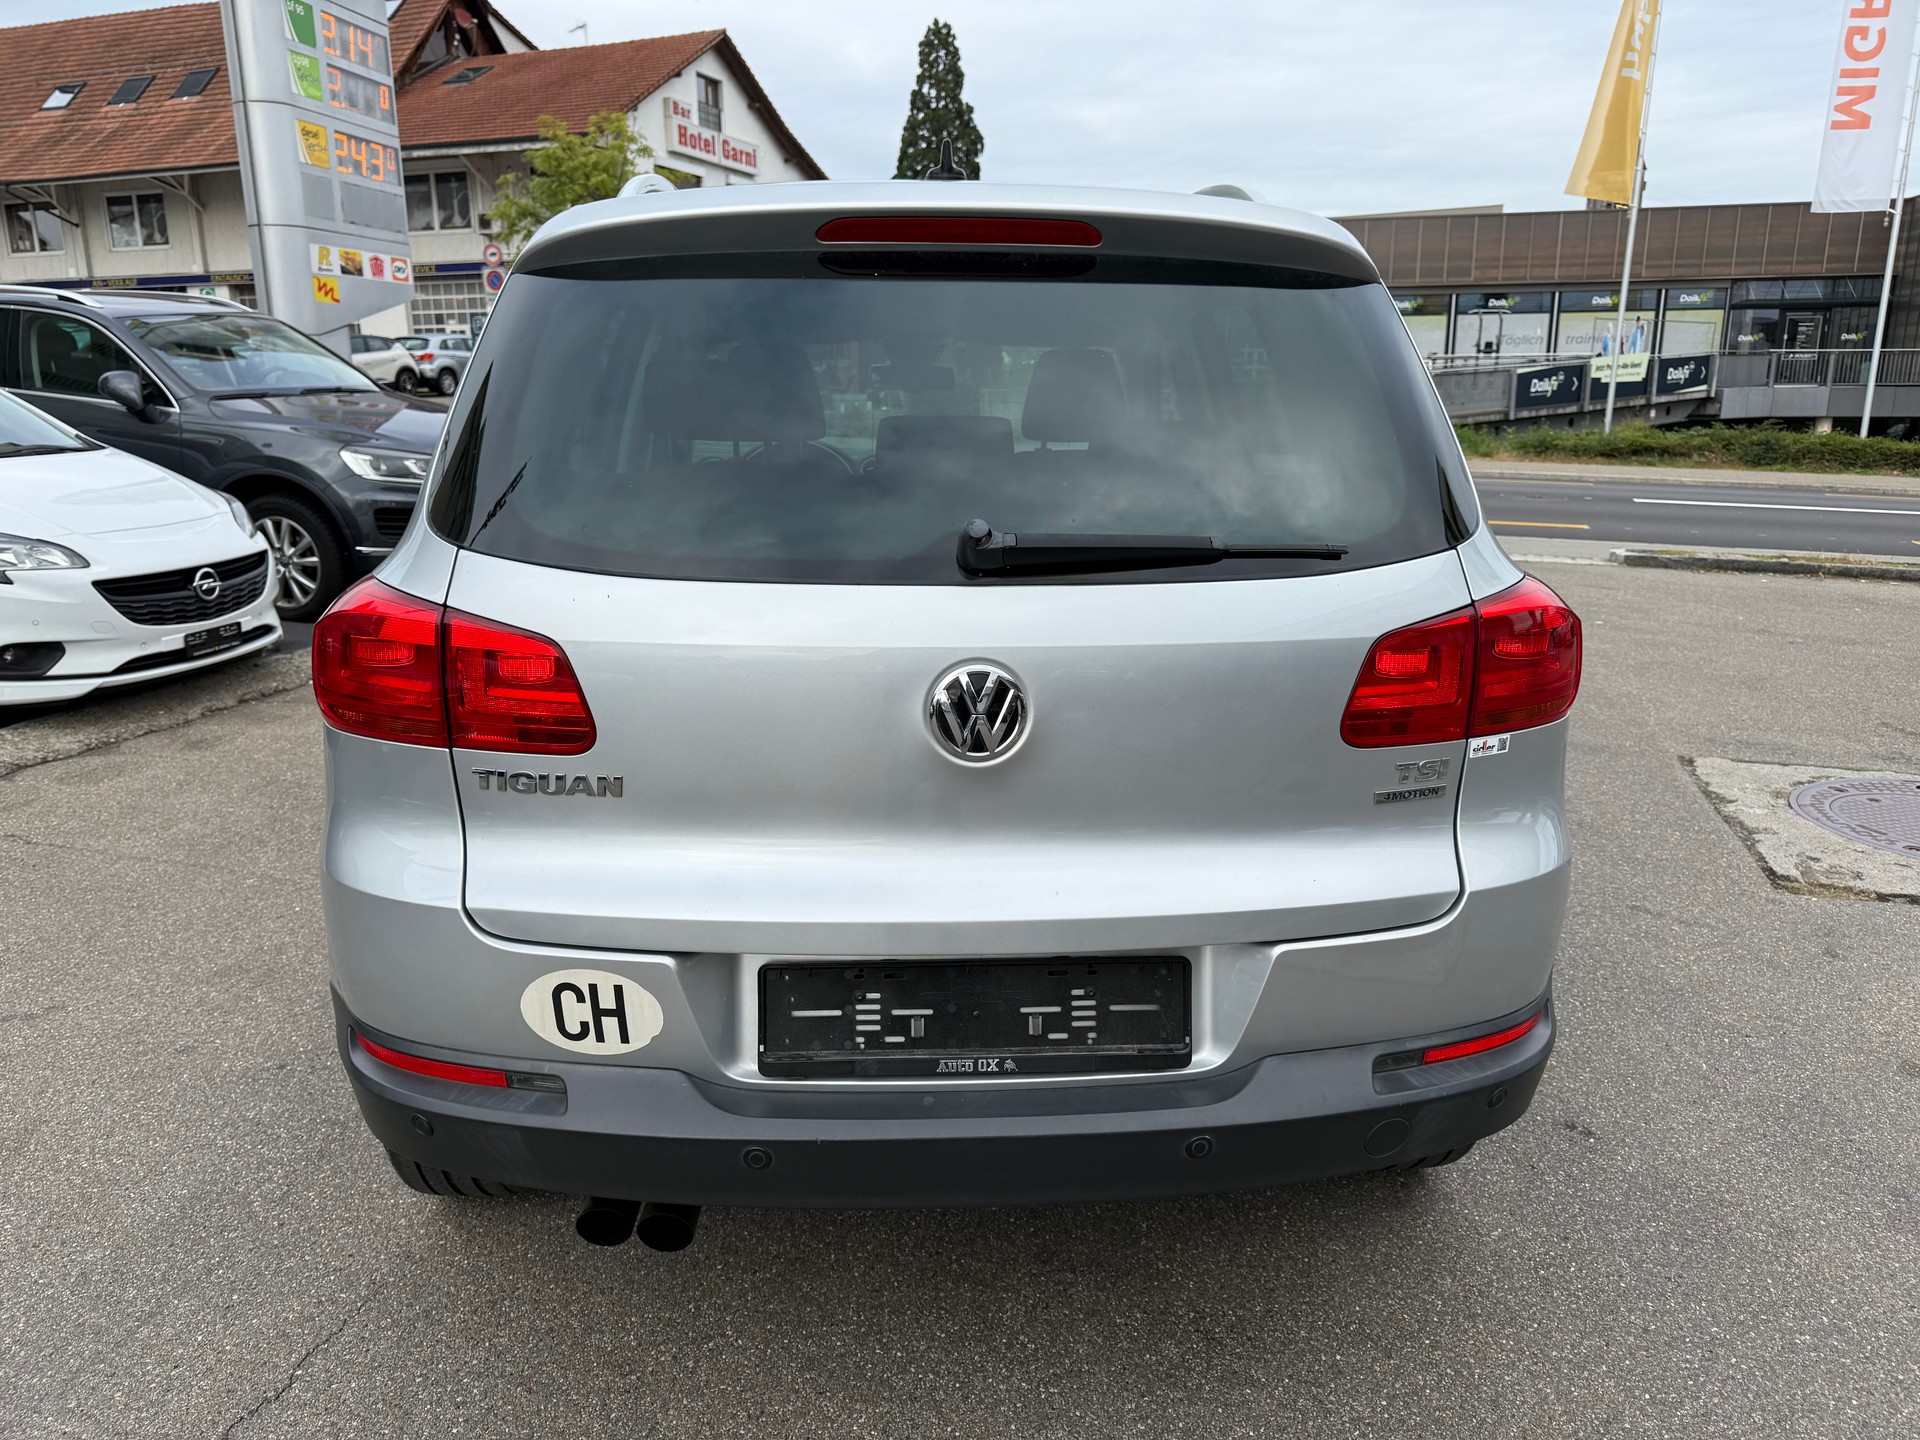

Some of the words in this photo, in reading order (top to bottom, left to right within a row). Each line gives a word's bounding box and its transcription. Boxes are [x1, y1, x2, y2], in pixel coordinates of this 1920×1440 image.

[672, 100, 691, 119] Bar
[678, 124, 716, 156] Hotel
[722, 138, 757, 168] Garni
[472, 767, 623, 798] TIGUAN
[1395, 757, 1450, 784] TSI
[1384, 787, 1440, 801] 4MOTION
[552, 982, 630, 1044] CH
[978, 1058, 999, 1072] OX
